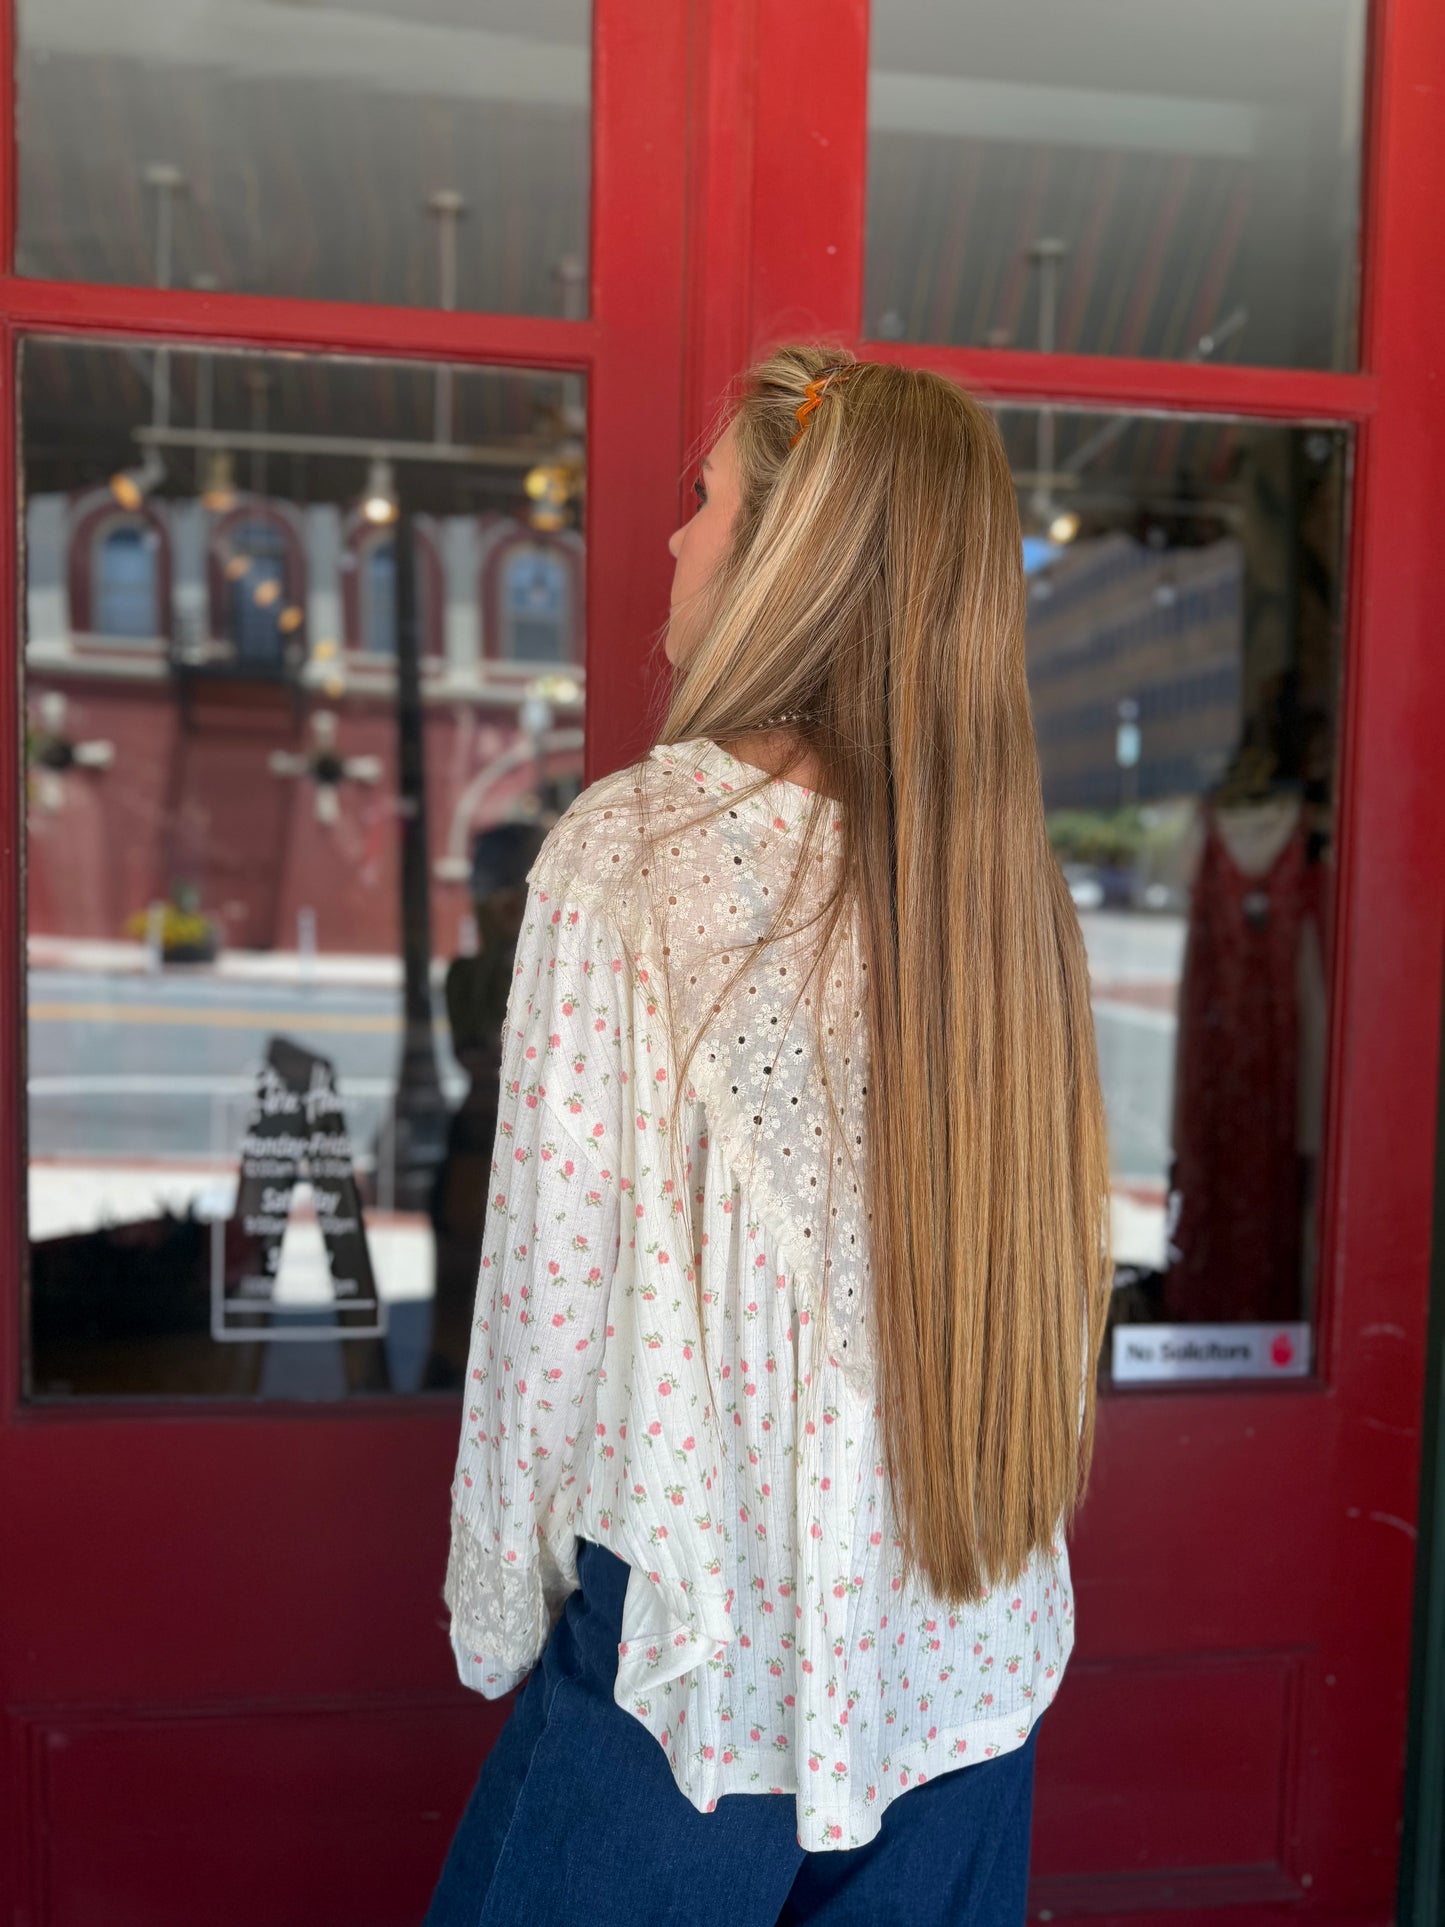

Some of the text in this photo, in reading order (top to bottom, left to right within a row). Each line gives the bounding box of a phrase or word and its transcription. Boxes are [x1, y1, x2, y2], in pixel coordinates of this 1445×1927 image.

[260, 1189, 341, 1216] Satday
[1127, 1341, 1251, 1361] No Solicitors
